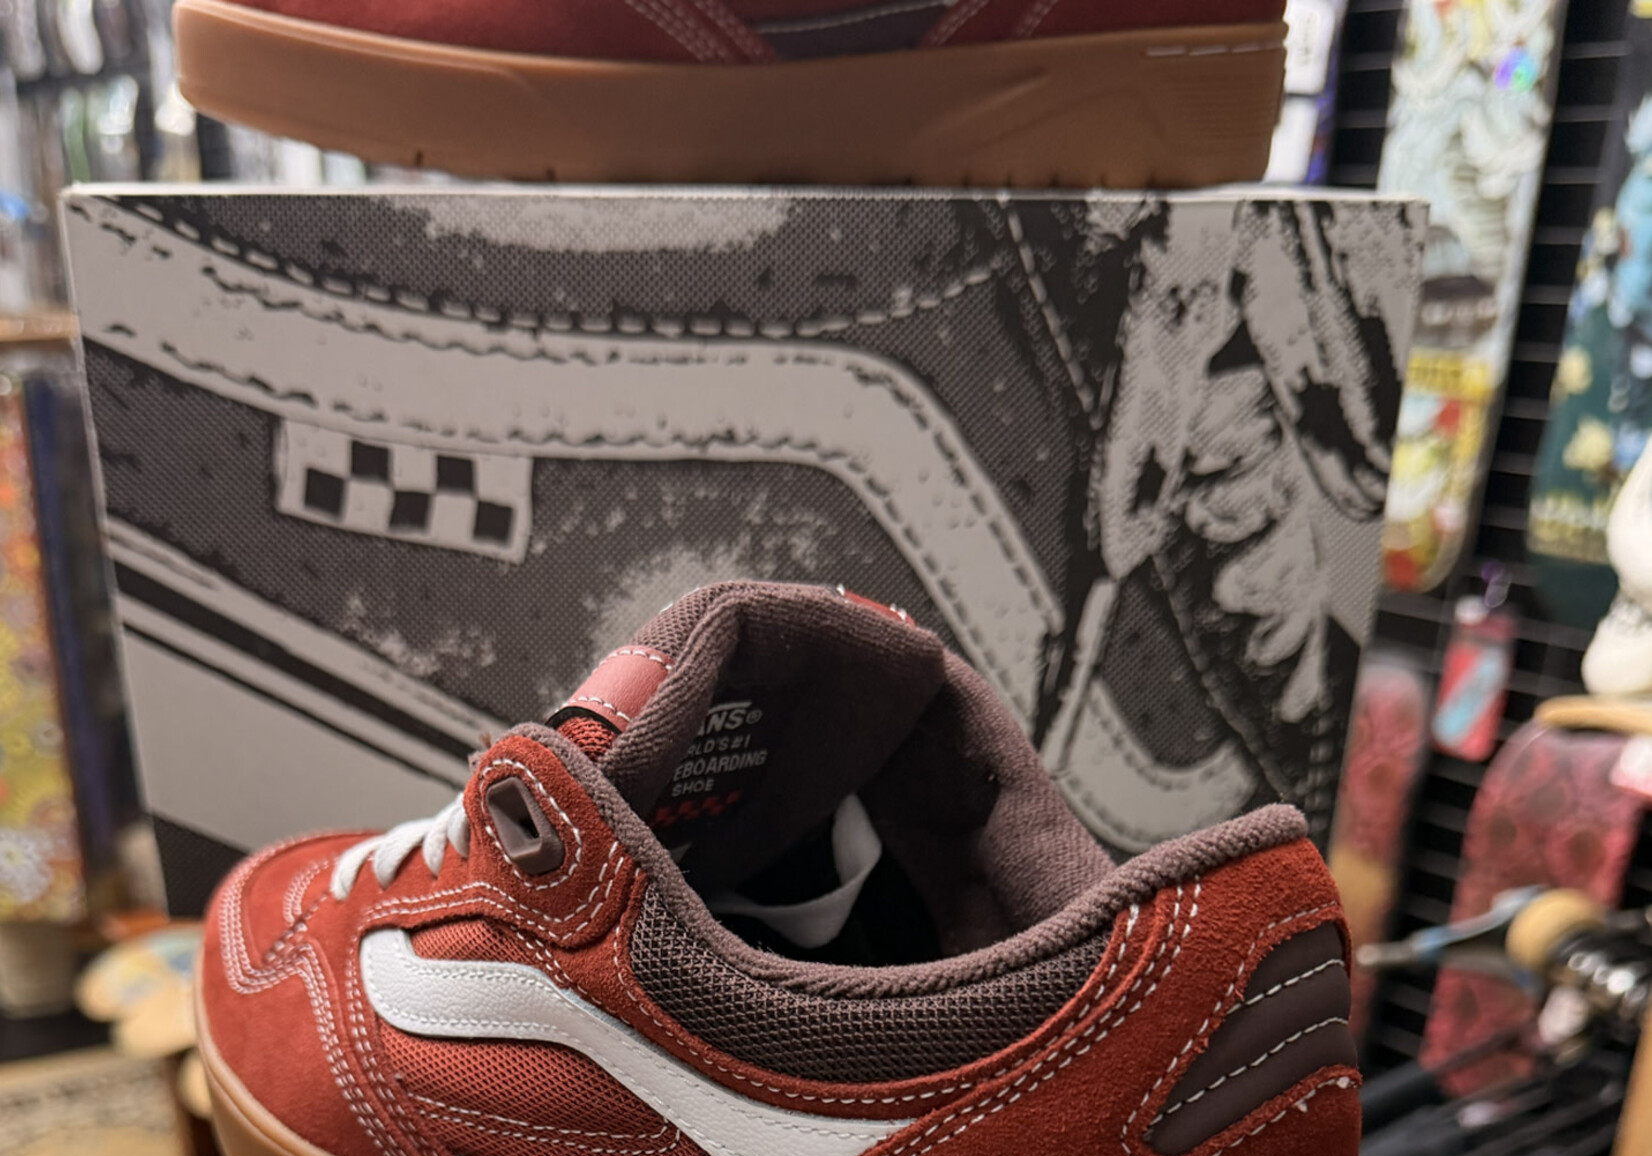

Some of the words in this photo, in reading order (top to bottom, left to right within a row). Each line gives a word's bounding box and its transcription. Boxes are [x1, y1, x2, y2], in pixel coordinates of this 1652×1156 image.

[697, 702, 763, 736] NS®
[687, 736, 729, 757] RLD'S
[673, 750, 768, 781] EBOARDING
[671, 778, 715, 797] SHOE
